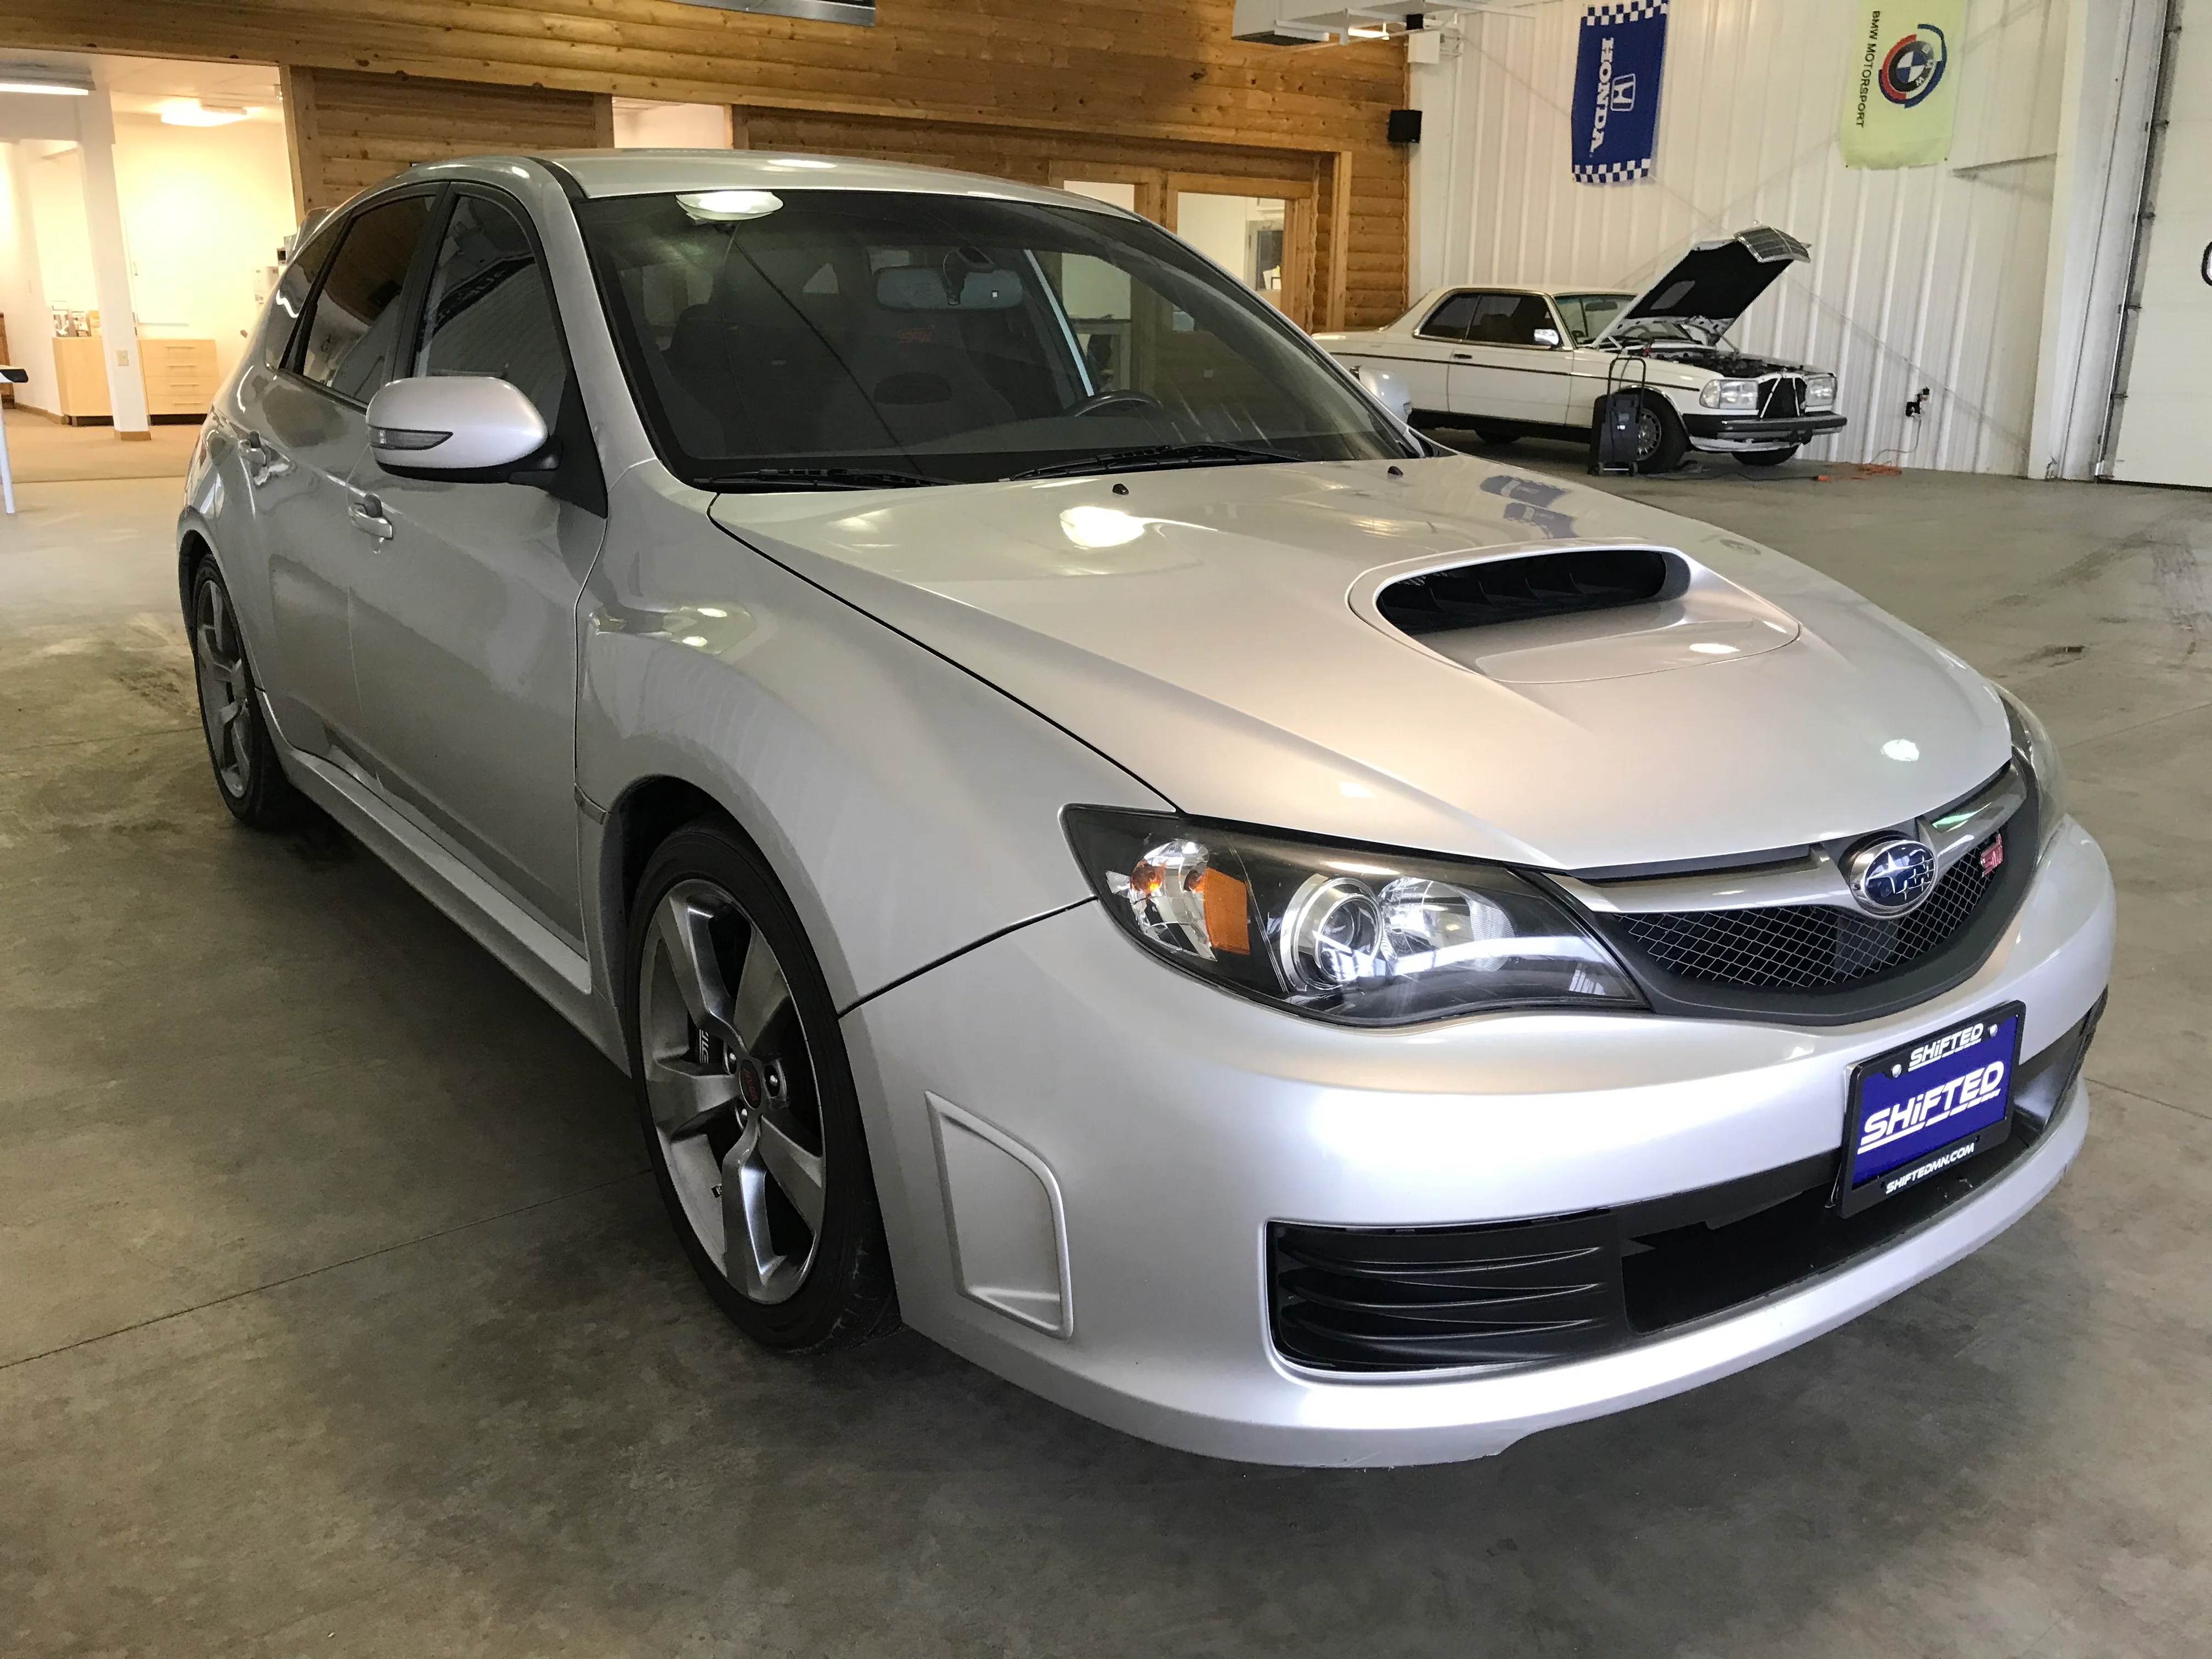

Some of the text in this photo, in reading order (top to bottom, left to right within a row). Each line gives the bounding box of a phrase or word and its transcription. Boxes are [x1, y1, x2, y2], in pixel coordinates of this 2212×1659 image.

[1590, 37, 1614, 153] HONDA
[1856, 10, 1880, 128] BMW MOTORSPORT
[1886, 1142, 1974, 1194] SHIFTEDMN.COM
